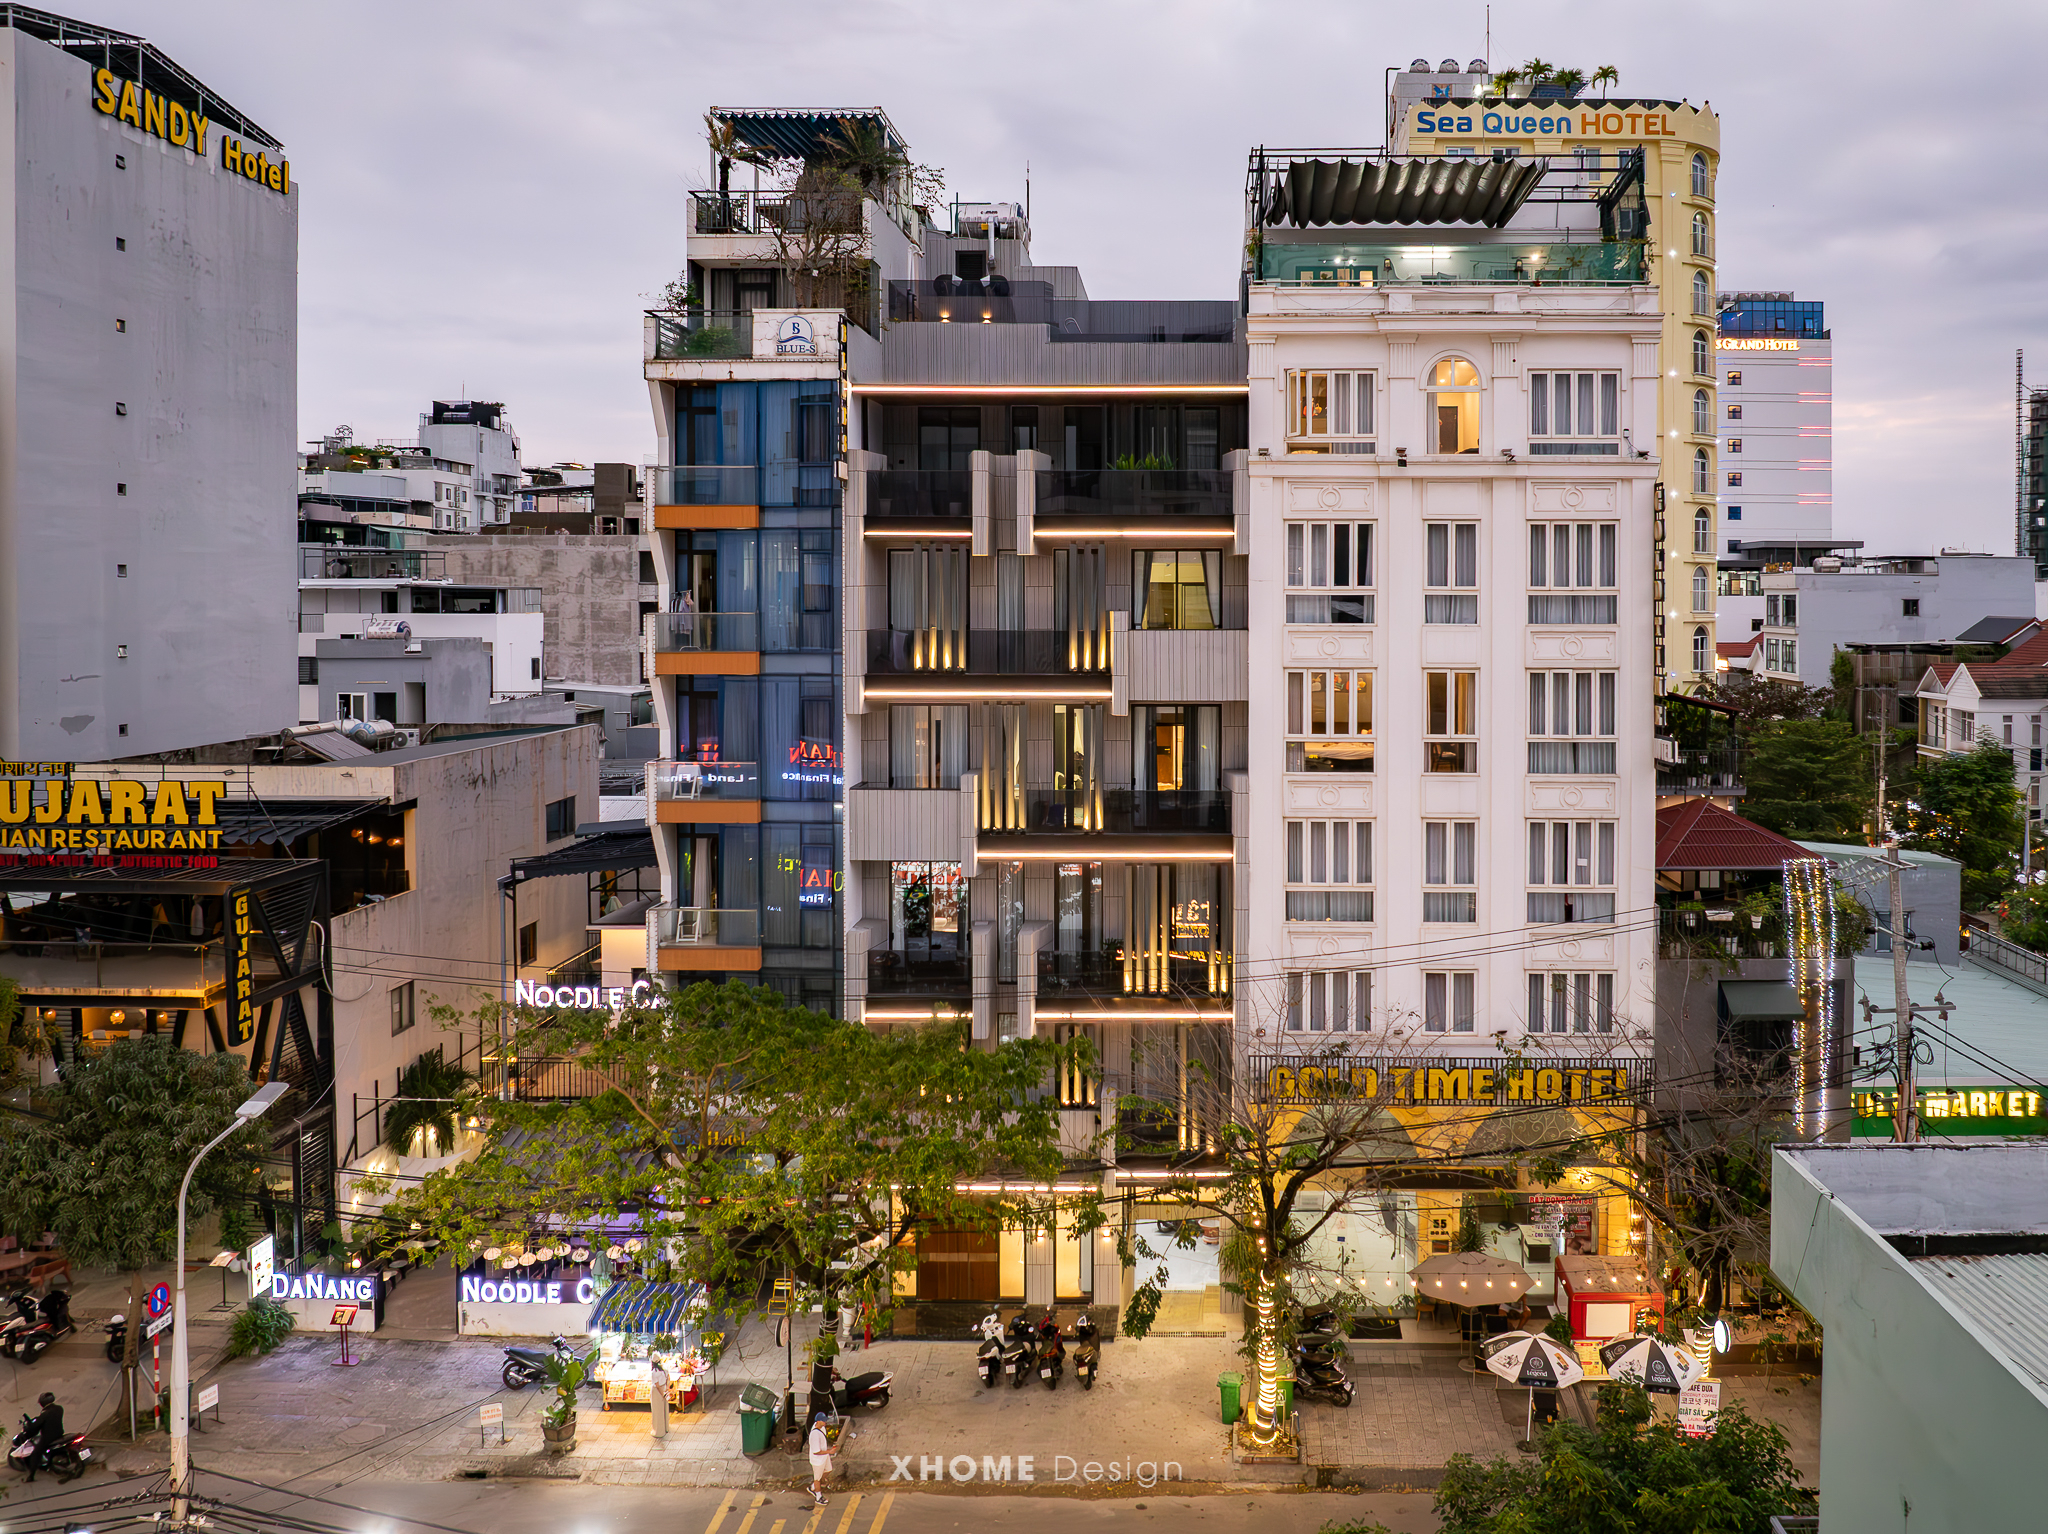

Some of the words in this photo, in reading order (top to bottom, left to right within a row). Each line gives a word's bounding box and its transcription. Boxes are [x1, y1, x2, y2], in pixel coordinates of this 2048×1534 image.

[95, 67, 209, 155] SANDY
[223, 134, 290, 195] Hotel
[1416, 110, 1473, 134] Sea
[1482, 112, 1572, 135] Queen
[1580, 112, 1676, 136] HOTEL
[776, 344, 817, 354] BLUE-S
[1722, 338, 1764, 350] GRAND
[1764, 338, 1800, 351] HOTEL
[51, 829, 224, 849] RESTAURANT
[119, 855, 183, 868] AUTHENTIC
[187, 855, 218, 868] FOOD
[234, 895, 252, 1041] GUJARAT
[1269, 1065, 1378, 1100] GOLD
[1388, 1067, 1495, 1100] TIME
[1507, 1067, 1628, 1101] HOTEL
[1925, 1091, 2041, 1118] MARKET
[272, 1272, 372, 1300] DANANG
[461, 1276, 562, 1304] NOODLE
[1526, 1369, 1548, 1378] Legend
[1651, 1375, 1672, 1383] Legend
